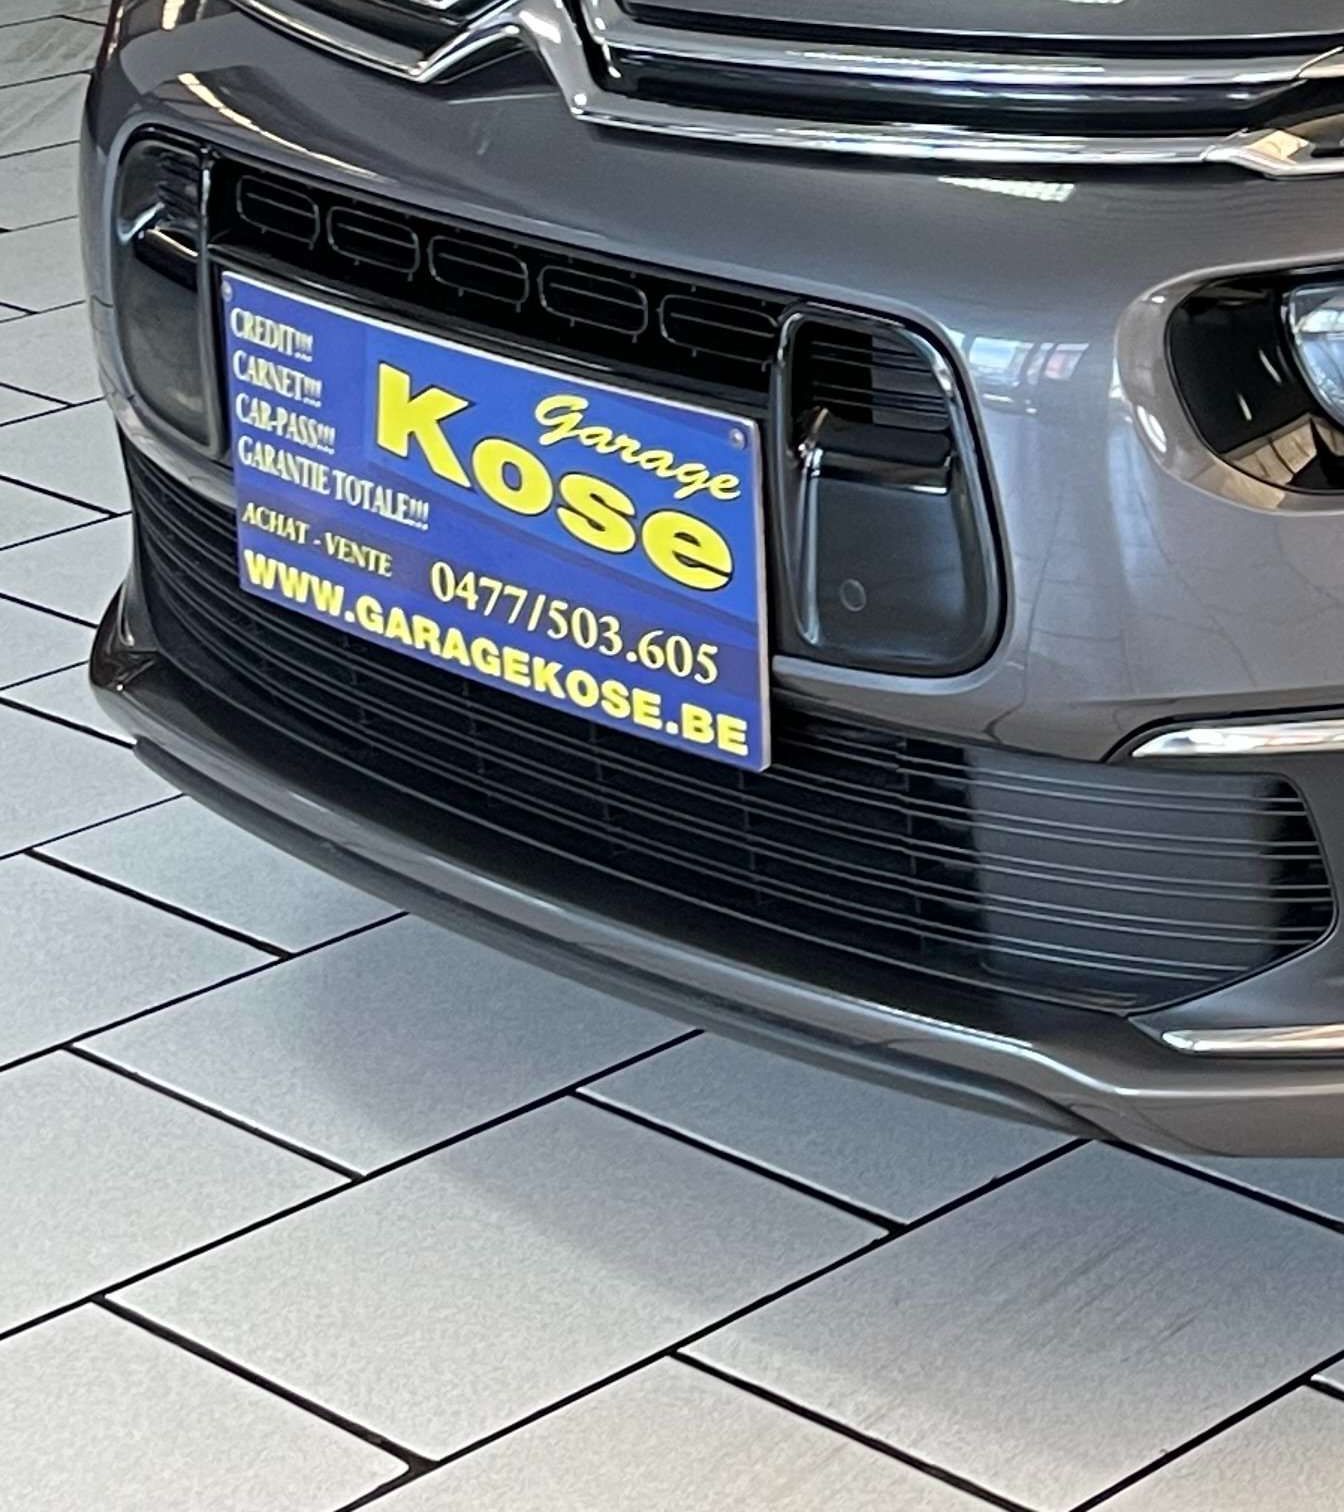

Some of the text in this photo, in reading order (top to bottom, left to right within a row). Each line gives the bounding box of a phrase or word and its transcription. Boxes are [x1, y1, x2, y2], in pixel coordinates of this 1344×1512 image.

[230, 307, 314, 363] CREDIT!!!
[233, 350, 323, 408] CARNET!!!
[235, 392, 336, 456] CAR-PASS!!!
[534, 394, 741, 501] Garage
[238, 435, 430, 531] GARANTIE TOTALE!!!
[376, 361, 735, 591] Kose
[242, 502, 311, 545] ACHAT
[324, 532, 393, 578] VENTE
[243, 548, 750, 757] WWW.GARAGEKOSE.BE
[430, 561, 719, 685] 0477/503.605
